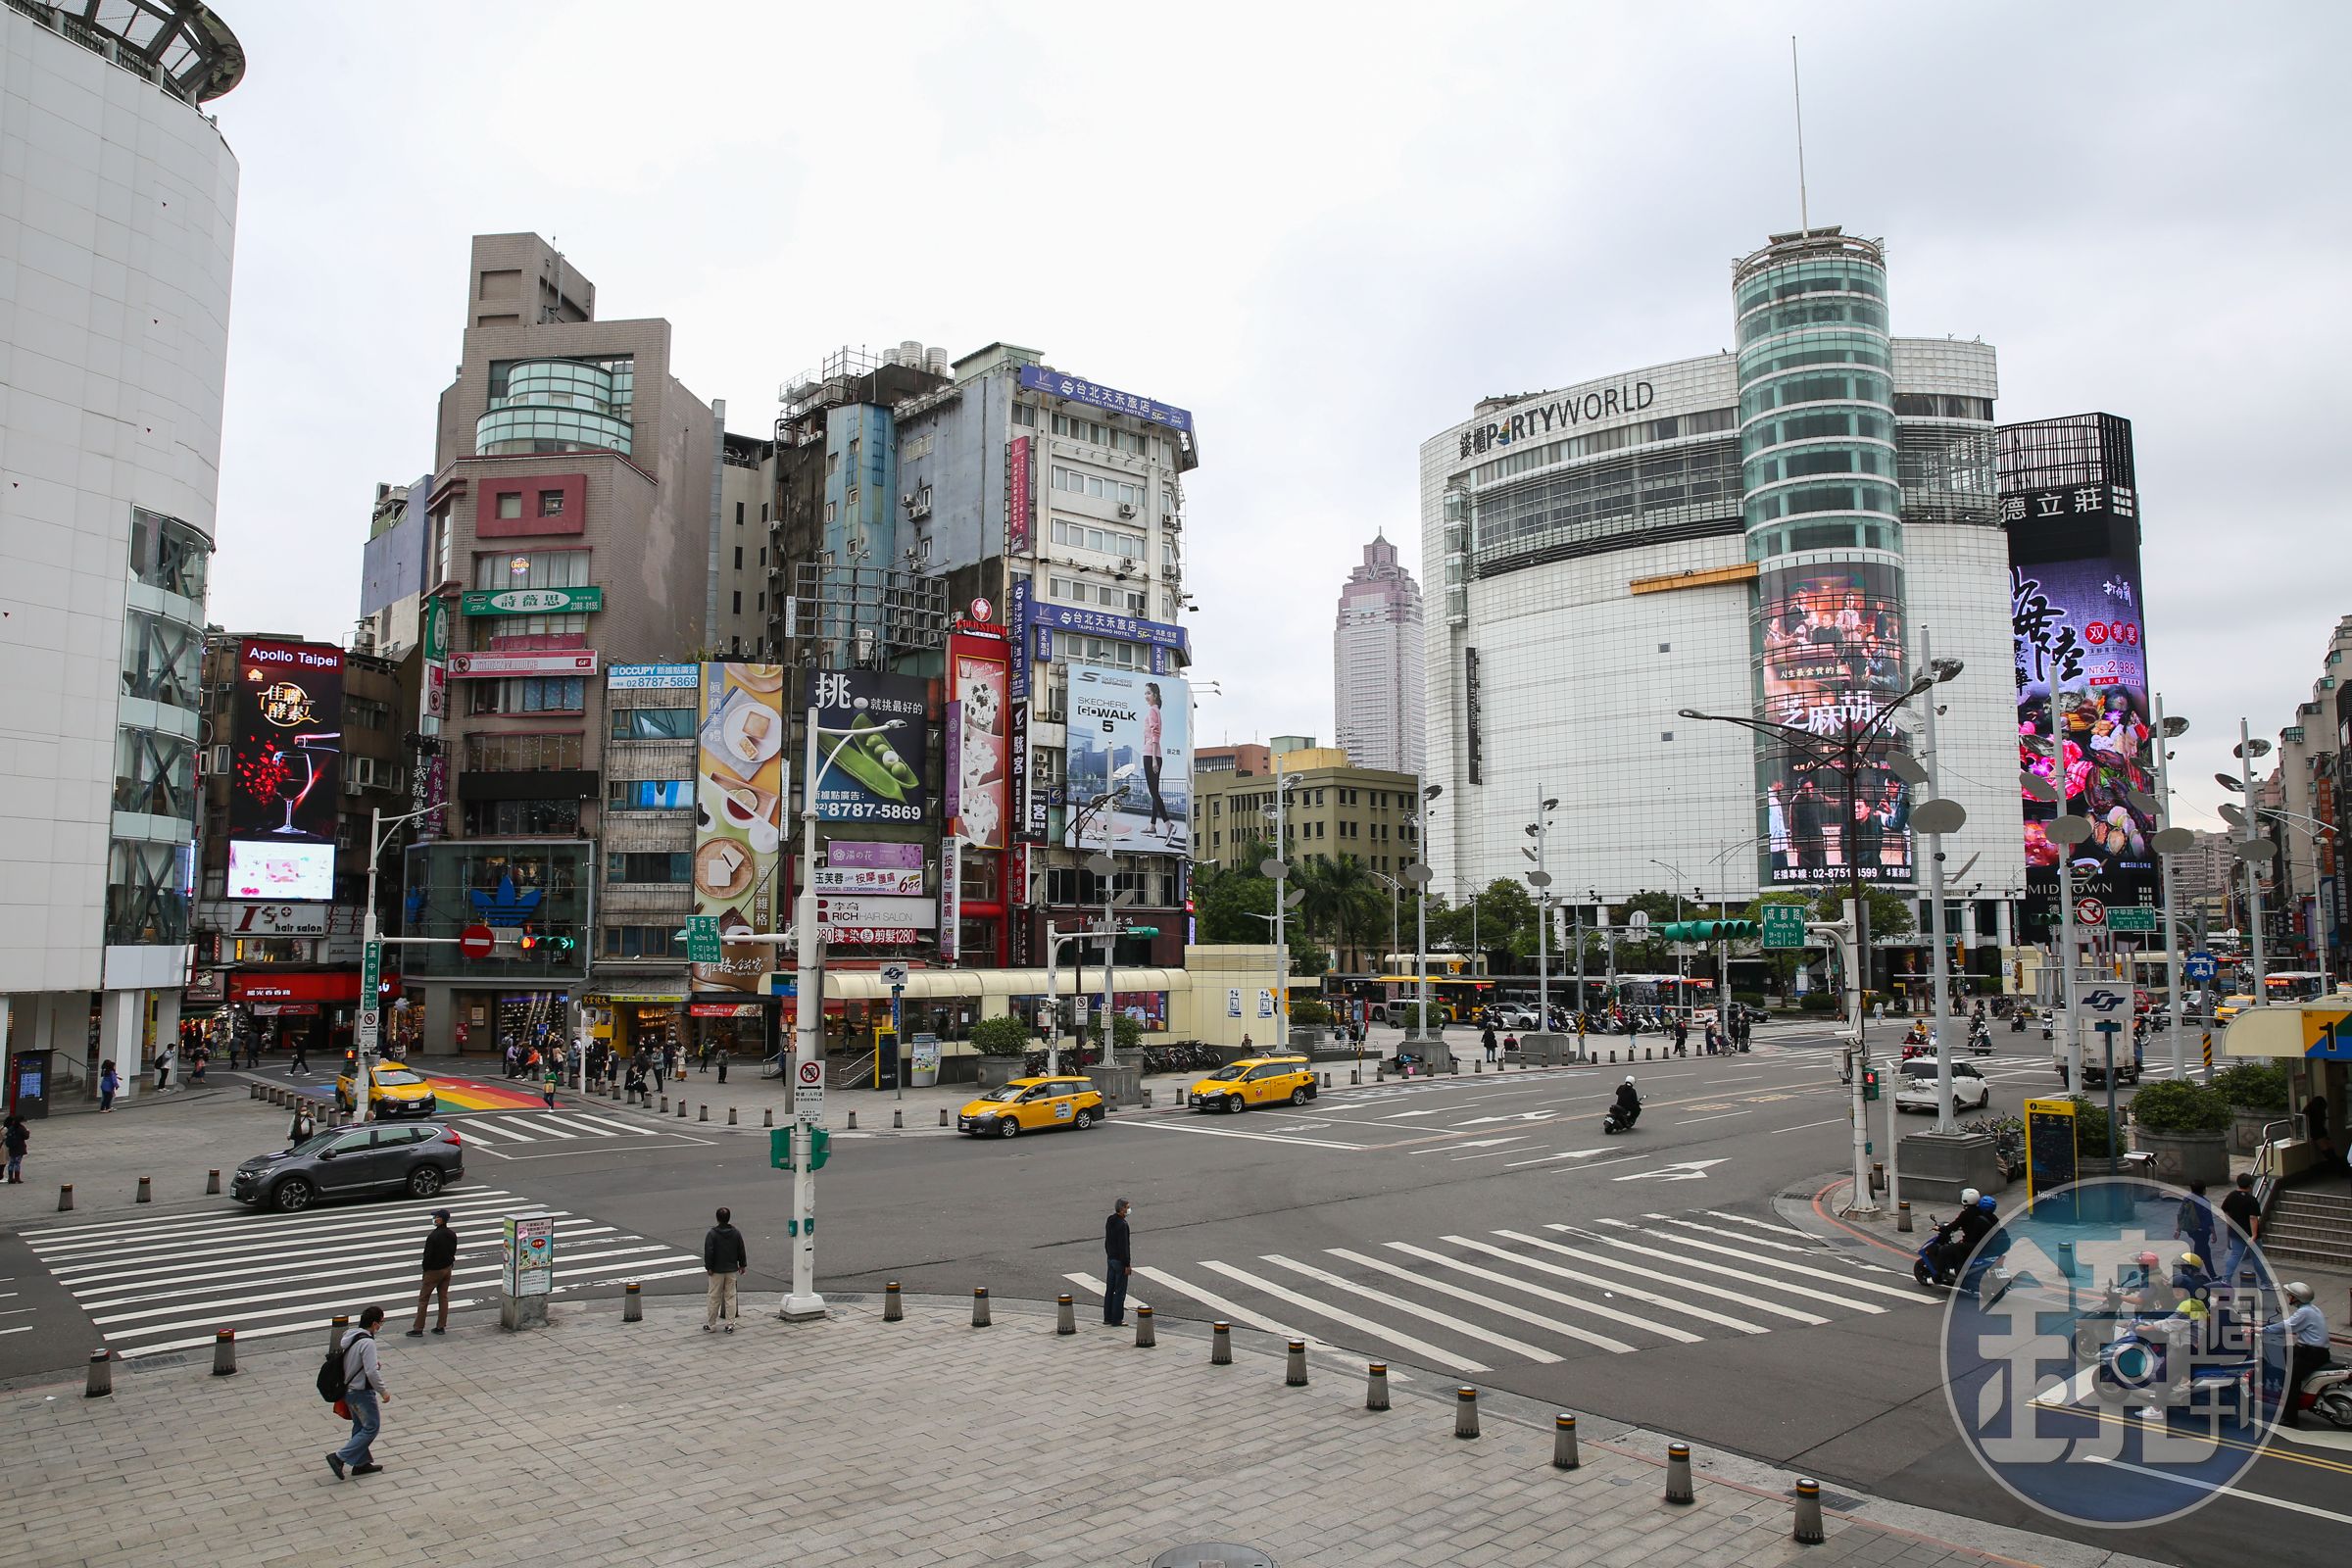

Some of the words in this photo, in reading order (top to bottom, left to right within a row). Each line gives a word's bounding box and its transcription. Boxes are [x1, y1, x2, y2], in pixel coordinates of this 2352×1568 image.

[1077, 381, 1150, 414] 台北天禾旅店
[1081, 396, 1102, 406] TAIPEI
[1125, 406, 1146, 417] HOTEL
[1999, 488, 2103, 523] 德立莊
[1074, 612, 1137, 633] 台北天禾旅店
[1077, 623, 1095, 632] TAIPEI
[249, 647, 294, 662] Apollo
[297, 652, 338, 667] Taipei
[619, 666, 655, 675] OCCUPY
[627, 679, 637, 688] 02
[638, 676, 697, 687] 8787-5869
[815, 672, 852, 710] 挑
[870, 698, 924, 715] 就挑最好的
[1078, 696, 1129, 710] SKECHERS
[1102, 719, 1114, 733] 5
[828, 802, 921, 820] 8787-5869
[815, 872, 844, 885] 玉芙蓉
[2028, 883, 2113, 895] MIDOWN
[832, 911, 858, 921] RICH
[859, 911, 881, 921] HAIR
[883, 912, 912, 922] SALON
[1768, 907, 1800, 920] 成都路
[275, 923, 294, 932] hair
[2319, 1021, 2337, 1052] 1
